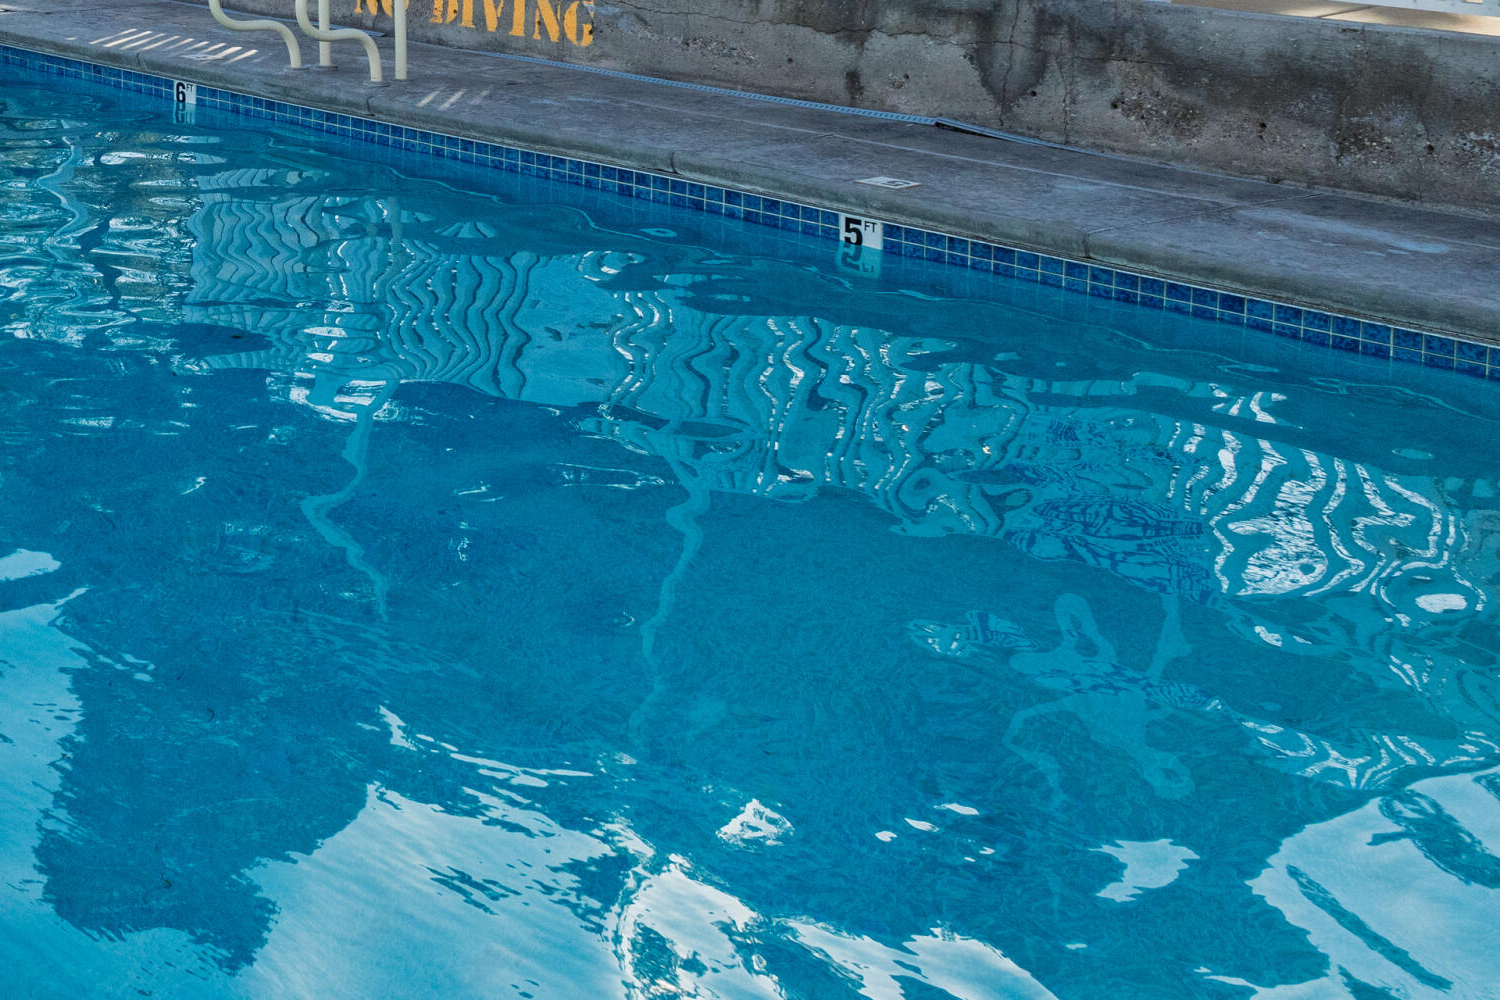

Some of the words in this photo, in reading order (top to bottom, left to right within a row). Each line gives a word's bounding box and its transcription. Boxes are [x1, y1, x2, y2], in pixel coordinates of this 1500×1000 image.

[176, 82, 186, 103] 6
[186, 83, 194, 92] FT
[844, 216, 863, 246] 5
[864, 220, 877, 233] FT
